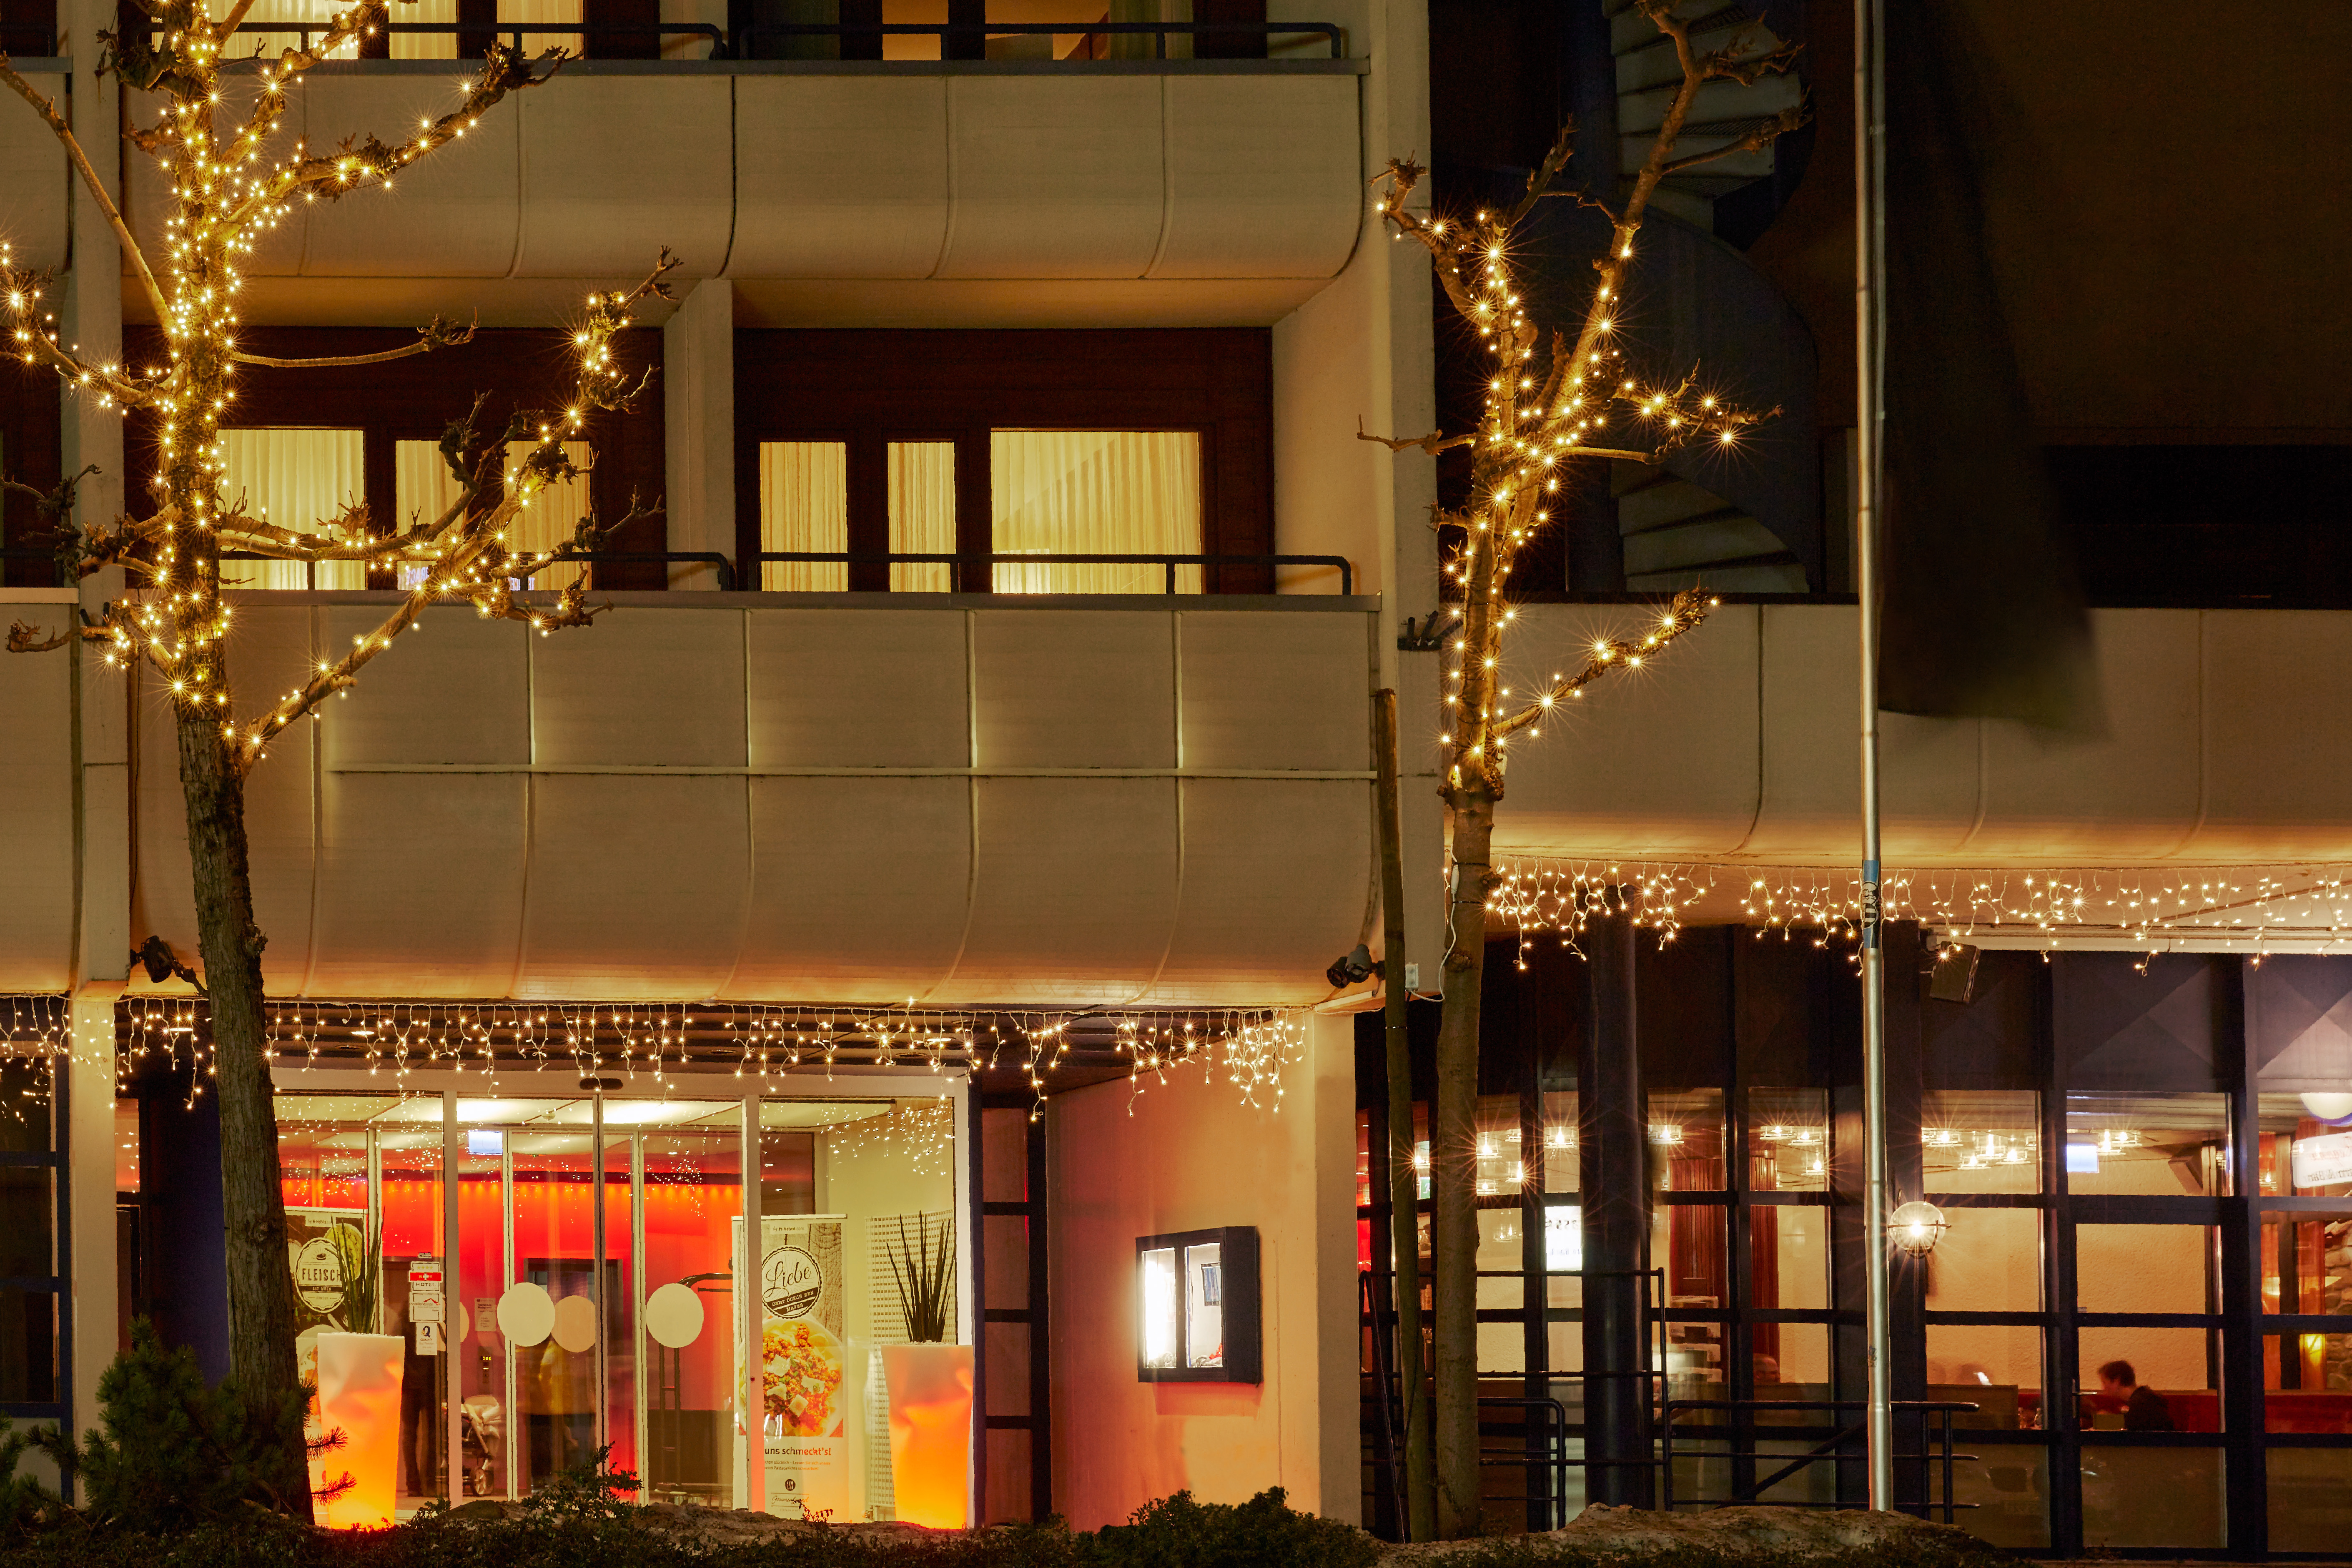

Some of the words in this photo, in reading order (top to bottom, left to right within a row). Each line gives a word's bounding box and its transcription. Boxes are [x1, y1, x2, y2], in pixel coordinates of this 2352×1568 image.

[302, 1268, 341, 1282] FLEISCH
[763, 1261, 811, 1298] Liebe
[787, 1294, 802, 1302] DURCH
[786, 1303, 803, 1312] MAGEN
[782, 1447, 831, 1455] schmeckt's!
